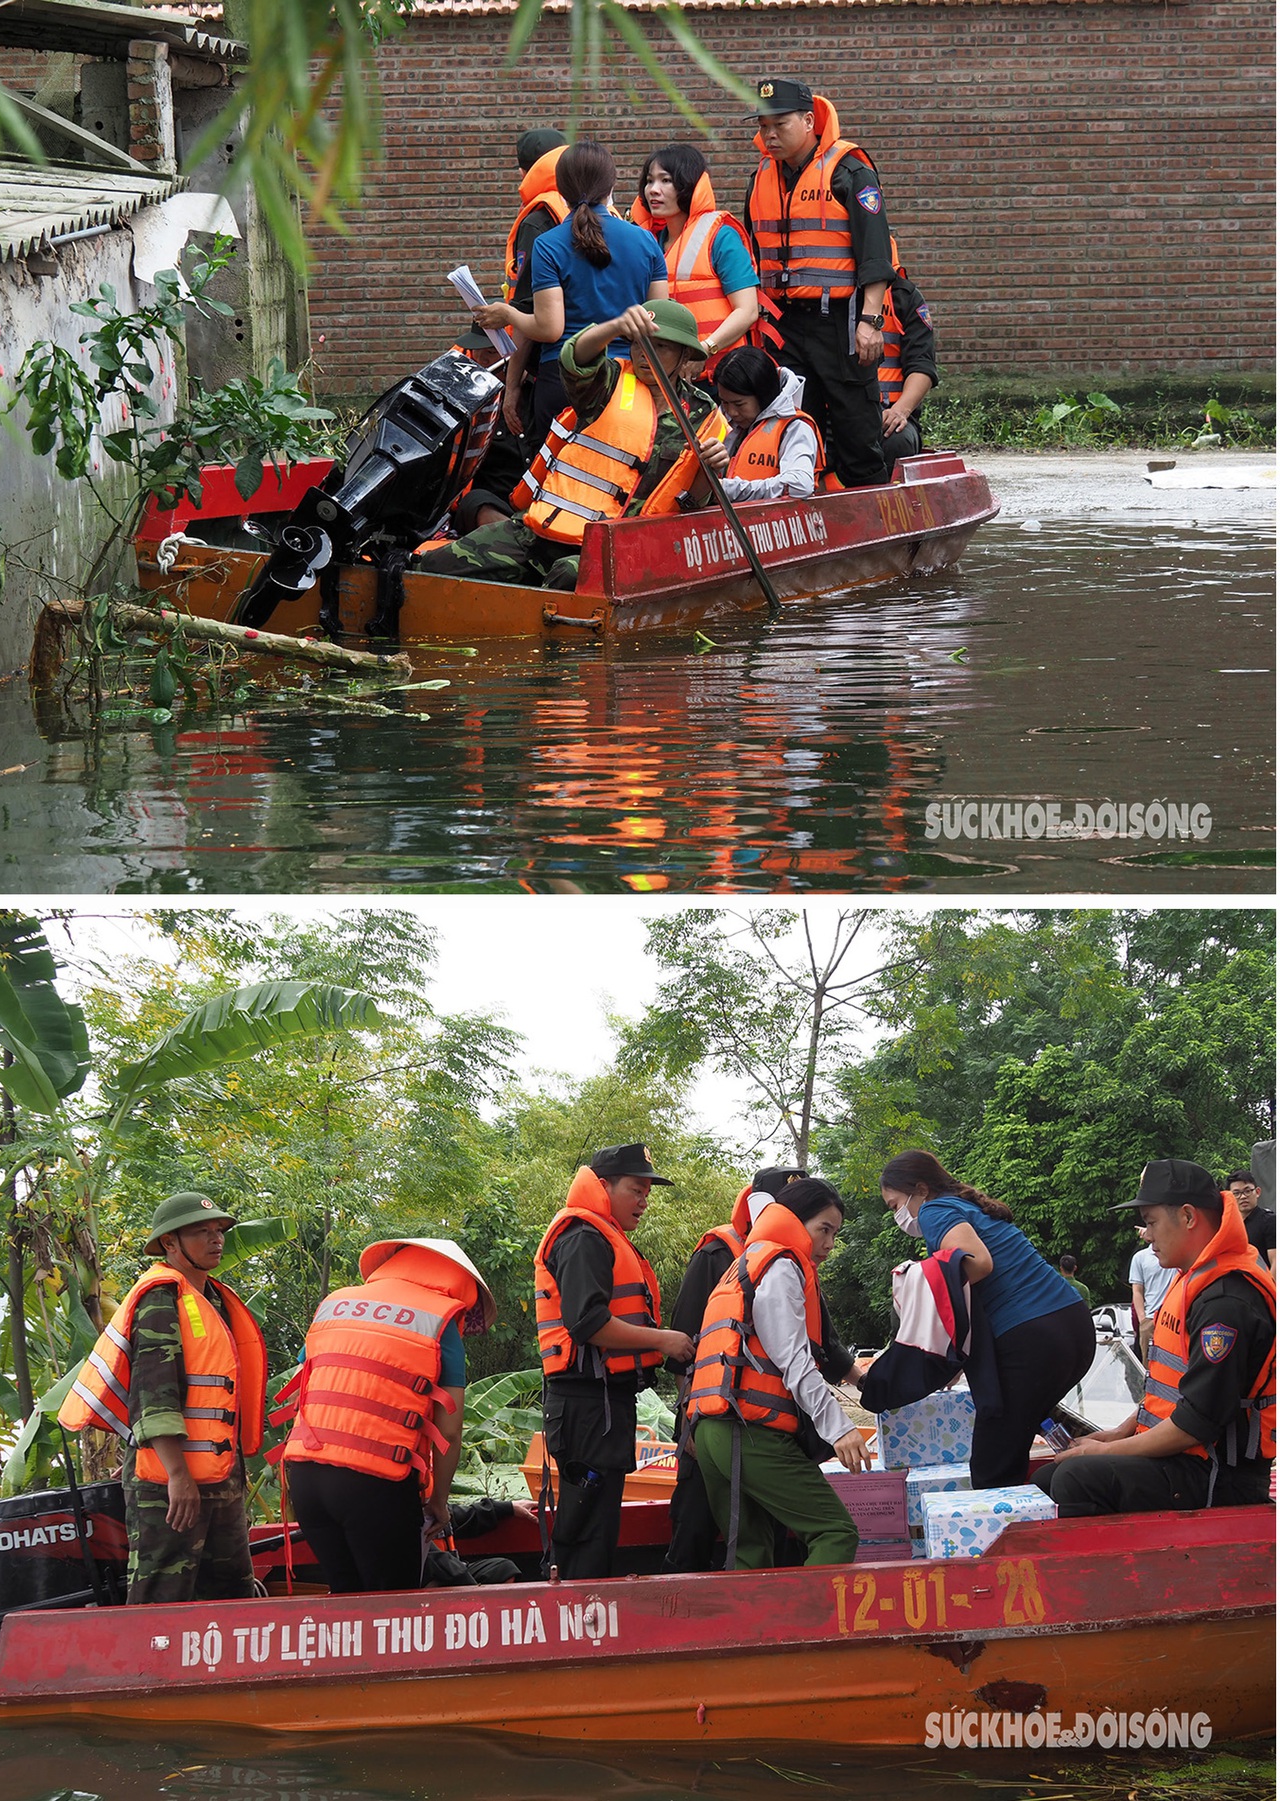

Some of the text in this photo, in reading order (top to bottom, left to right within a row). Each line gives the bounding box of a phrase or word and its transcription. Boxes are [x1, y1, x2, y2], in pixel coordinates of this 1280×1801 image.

[683, 528, 703, 572] BỘ
[702, 529, 719, 564] TƯ
[718, 523, 747, 565] LỆN
[788, 511, 807, 546] HÀ
[804, 506, 828, 545] NỘI
[333, 1301, 416, 1325] CSCĐ
[181, 1621, 222, 1672] BỘ
[232, 1622, 275, 1663] TƯ
[281, 1615, 363, 1666] LỆNH
[500, 1600, 547, 1646] HÀ
[558, 1594, 619, 1646] NỘI
